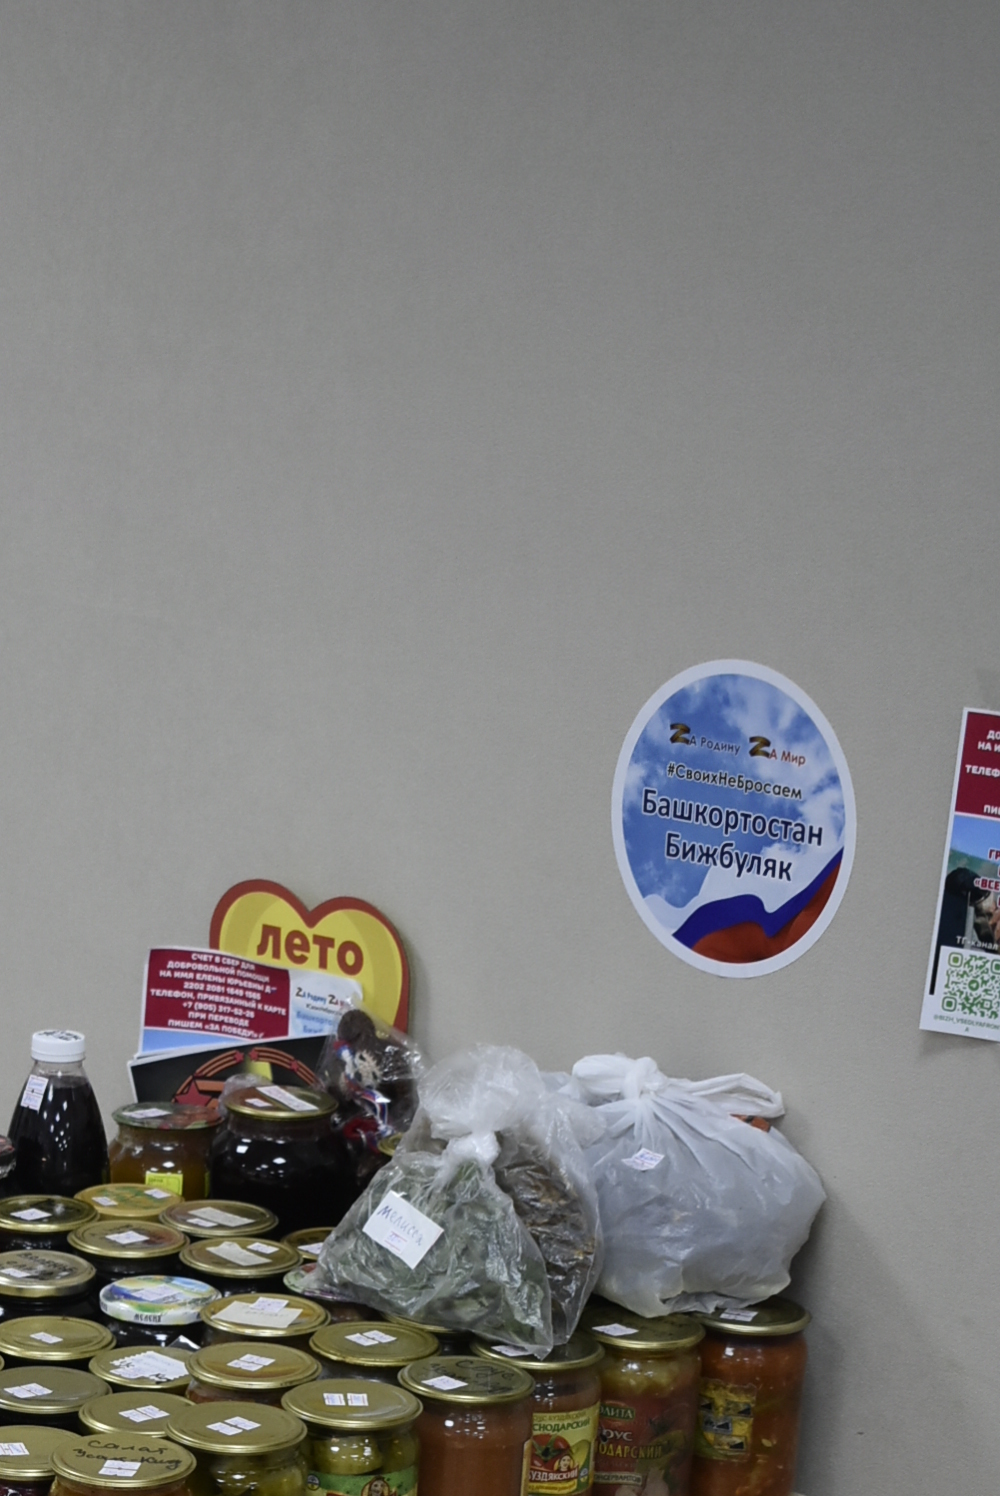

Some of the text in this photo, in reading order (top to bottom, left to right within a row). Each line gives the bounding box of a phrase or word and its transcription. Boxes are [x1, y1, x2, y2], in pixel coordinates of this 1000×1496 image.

[781, 750, 806, 766] Мир
[965, 764, 1000, 778] ТЕЛЕФ
[667, 762, 803, 800] #СвоихНеБросаем
[642, 788, 823, 847] Башкортостан
[665, 832, 792, 882] Бижбуляк
[159, 970, 172, 978] НА
[173, 971, 194, 980] ИМЯ
[166, 960, 235, 976] ДОБРОВОЛЬНОЙ
[532, 1417, 590, 1433] СНОДАРСКИЙ
[601, 1428, 633, 1442] ОУС
[596, 1442, 662, 1459] ОДАРСКИЙ
